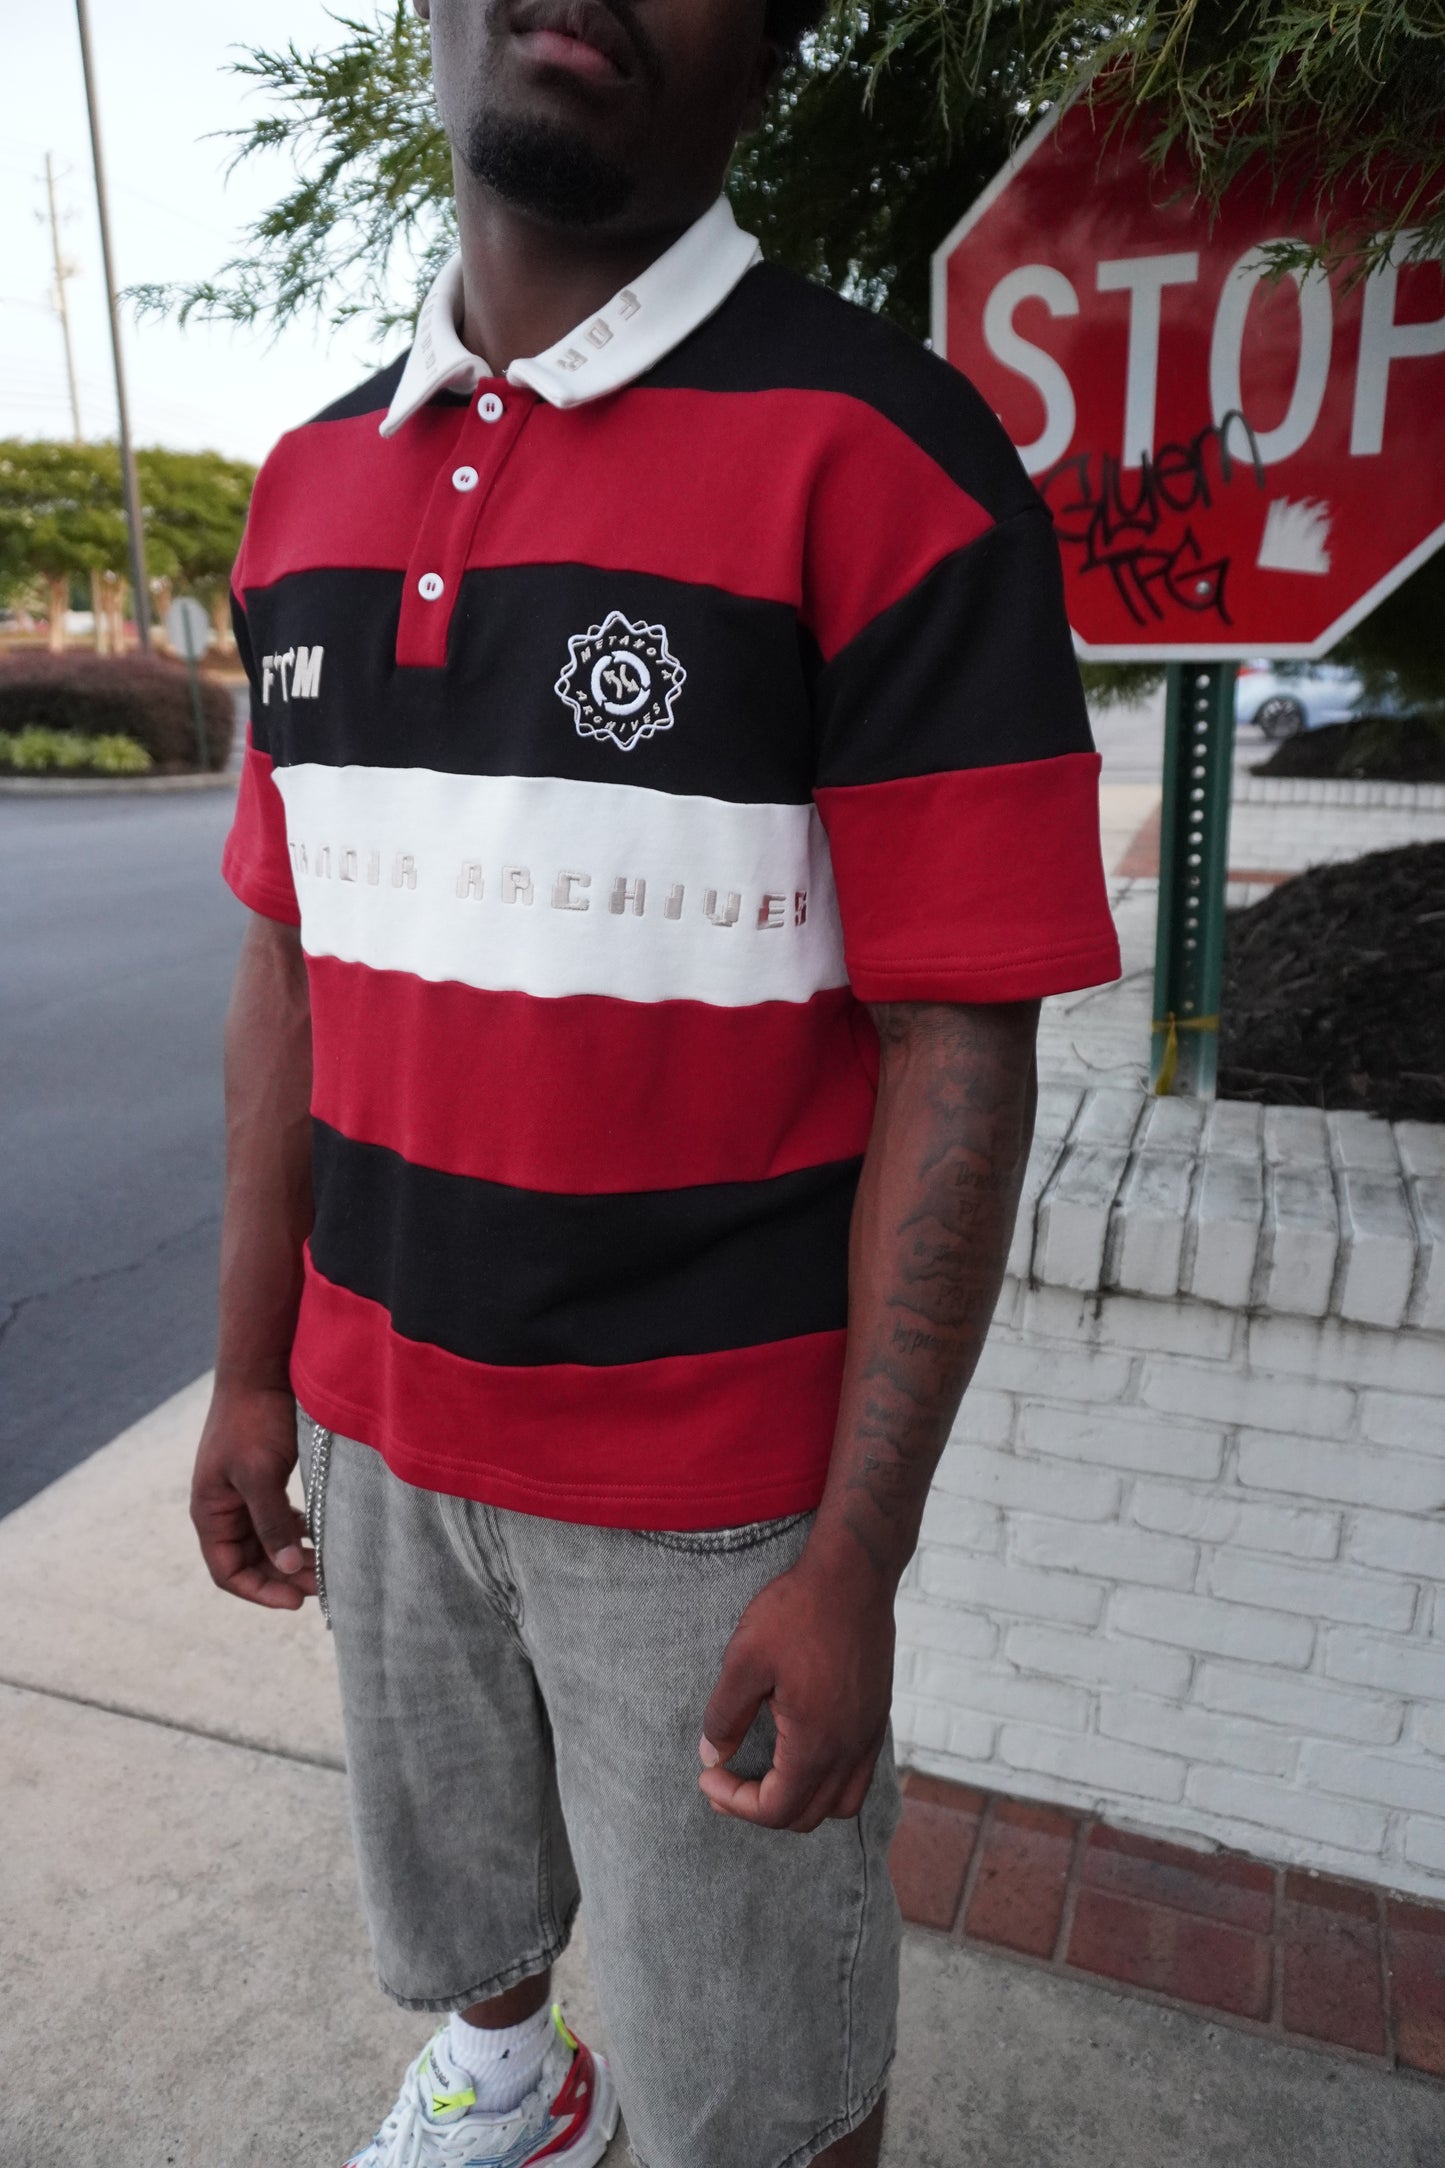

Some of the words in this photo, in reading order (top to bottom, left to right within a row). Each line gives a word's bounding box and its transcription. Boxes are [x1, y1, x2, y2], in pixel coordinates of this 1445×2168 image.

[982, 226, 1445, 480] STOP
[580, 634, 674, 681] METANOIA
[576, 689, 661, 733] ARCHIVES
[455, 862, 807, 930] ARCHIVES
